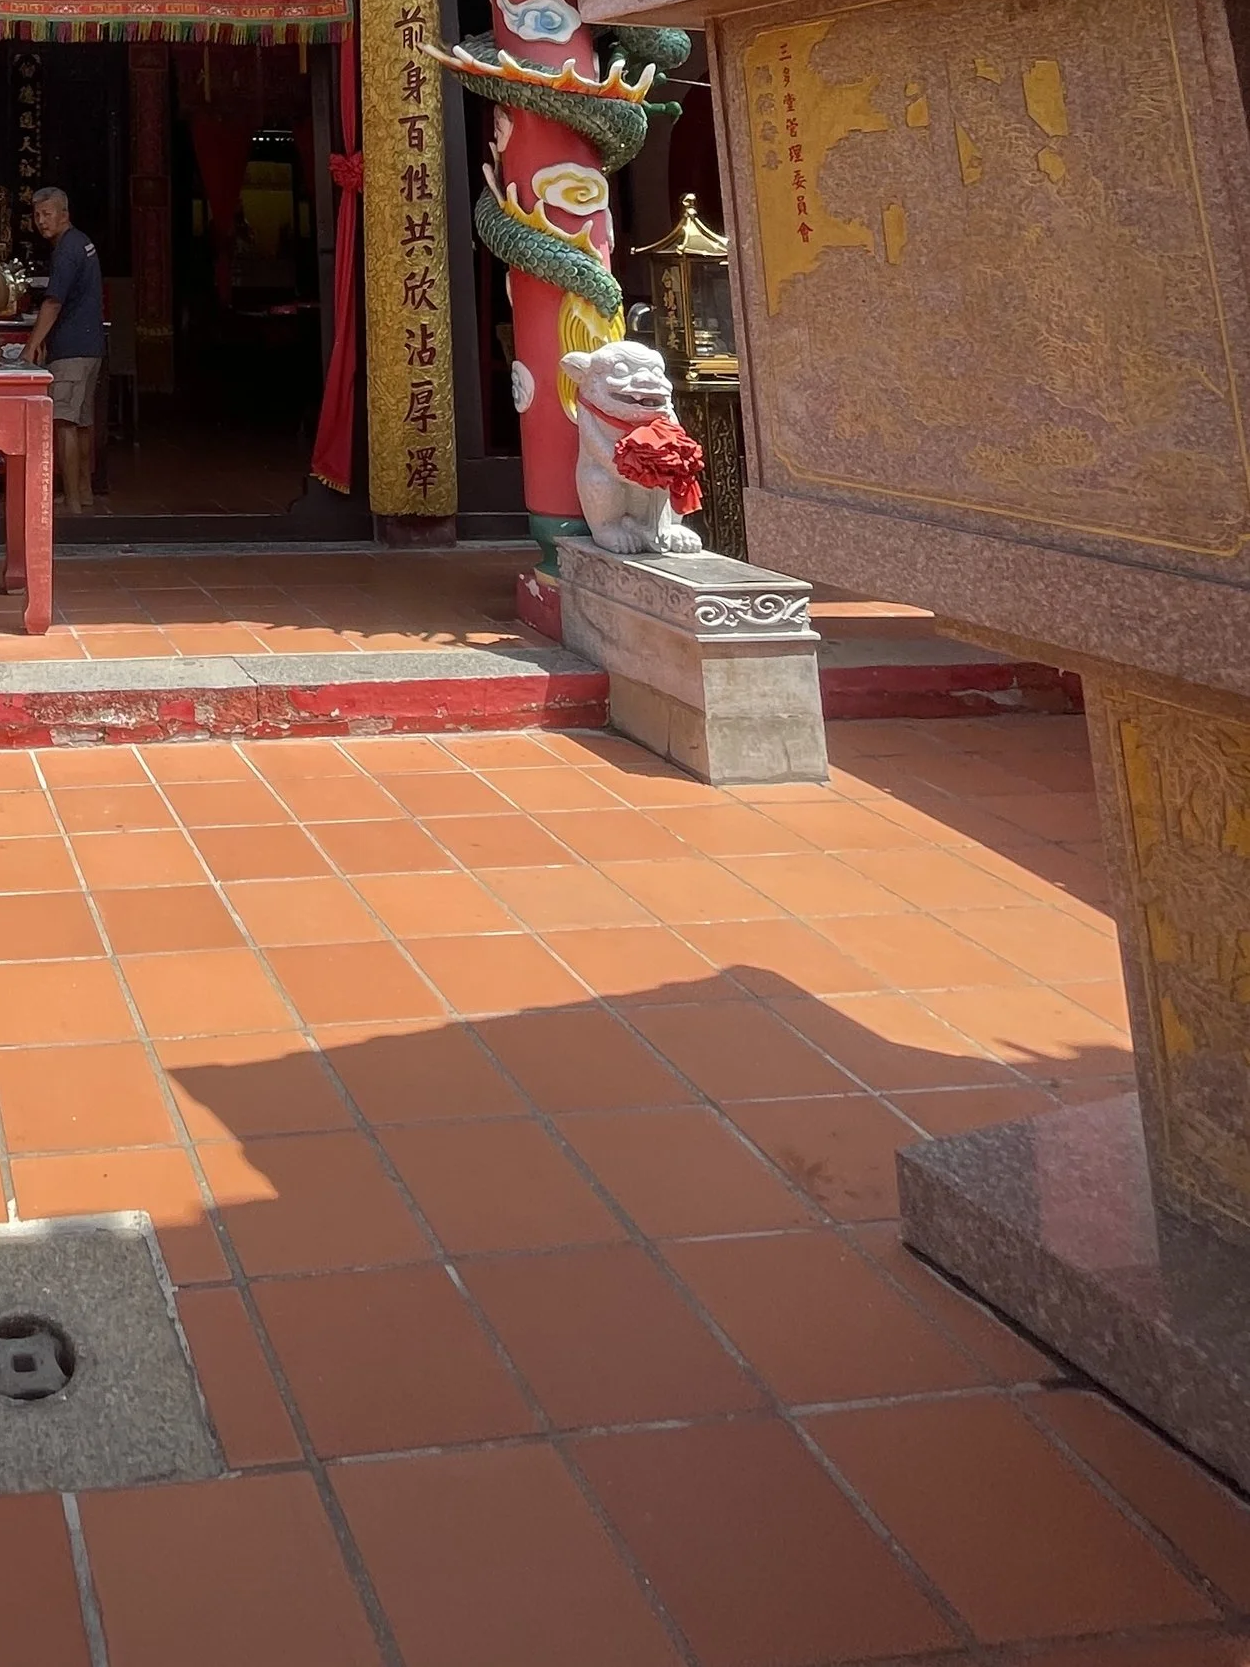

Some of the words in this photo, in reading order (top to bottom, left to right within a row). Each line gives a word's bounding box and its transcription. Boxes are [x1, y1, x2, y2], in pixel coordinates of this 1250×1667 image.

[778, 43, 813, 242] 三多堂管理委員會
